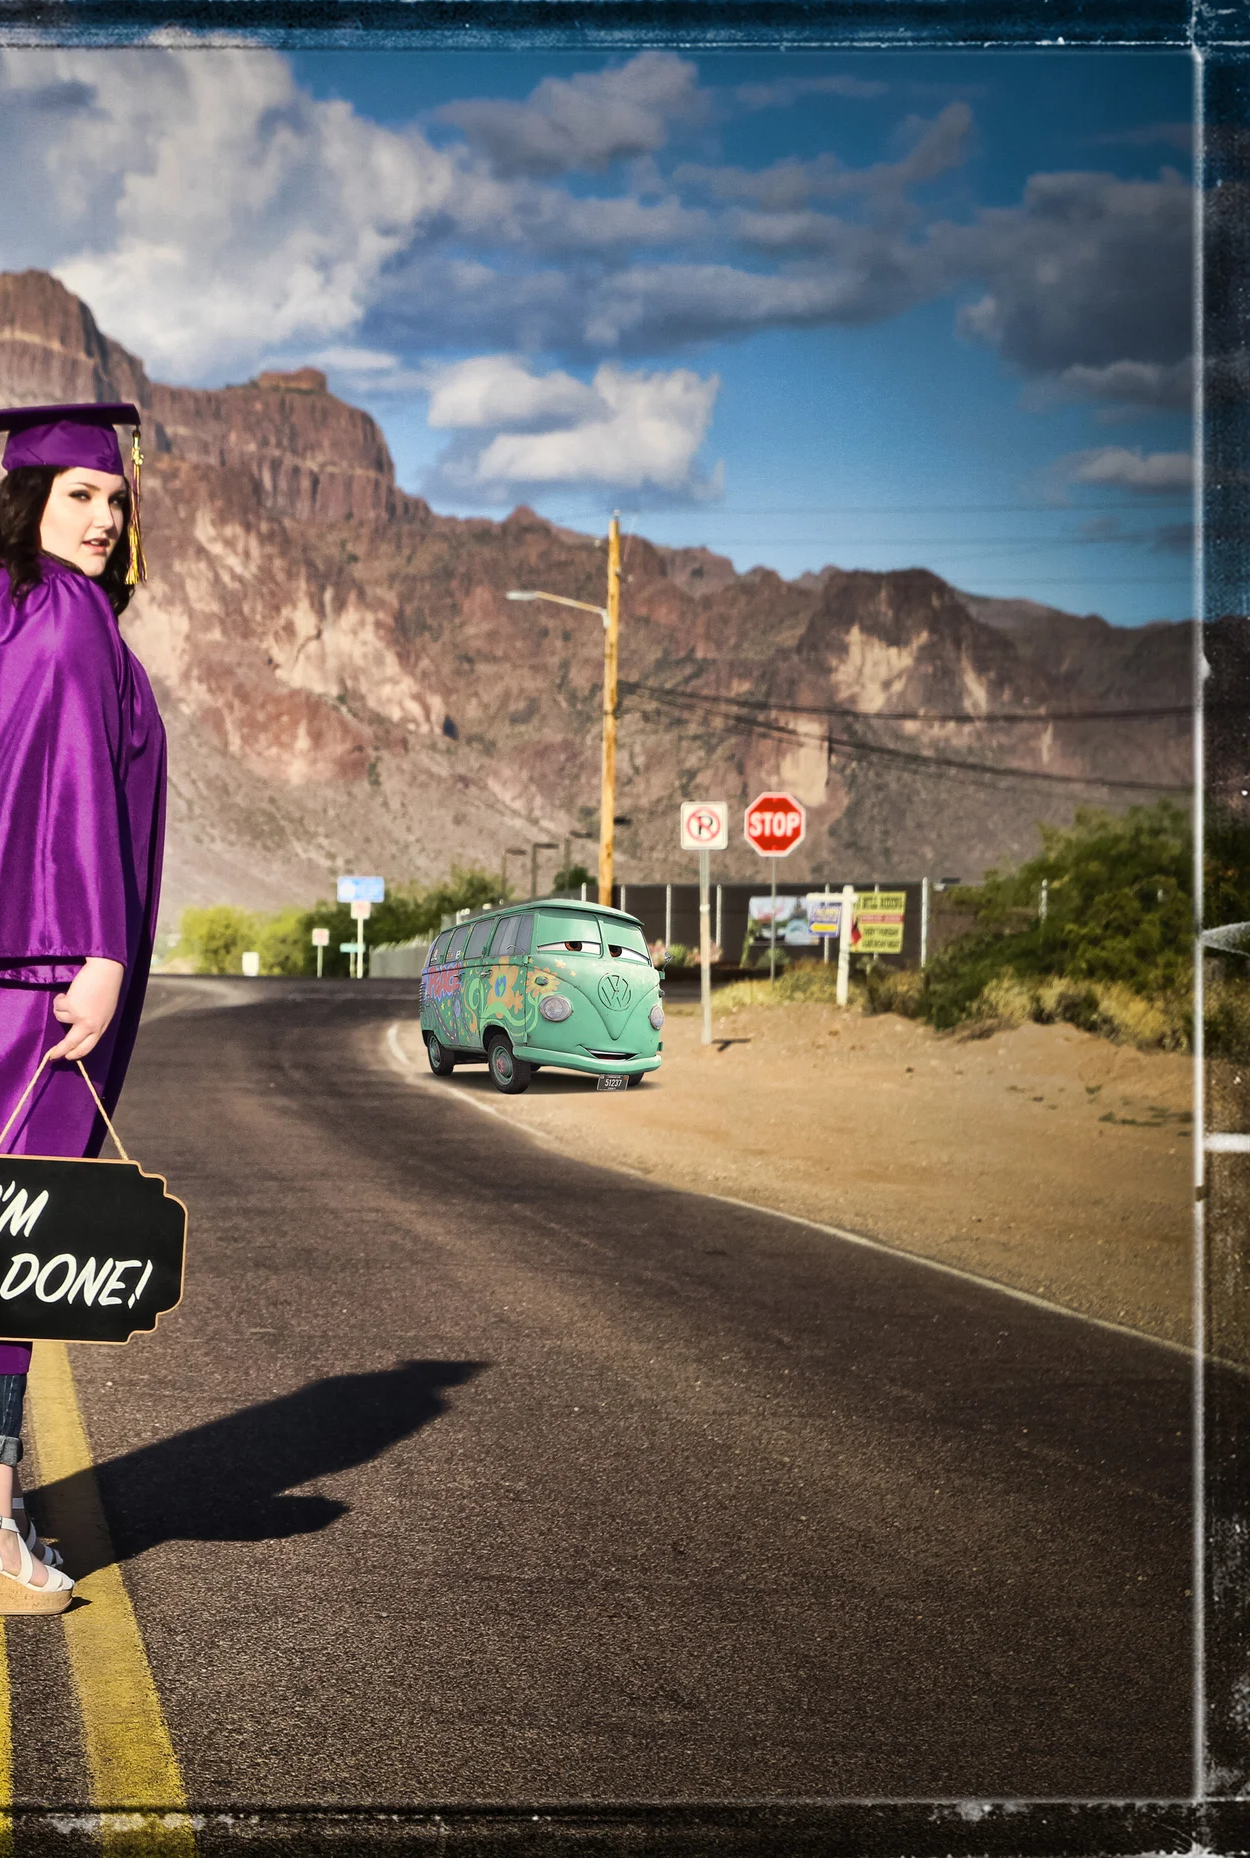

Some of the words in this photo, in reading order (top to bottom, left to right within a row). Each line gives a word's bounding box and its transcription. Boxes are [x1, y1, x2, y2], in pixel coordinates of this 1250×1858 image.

[749, 811, 801, 838] STOP
[604, 1078, 622, 1087] 51237
[0, 1252, 153, 1309] DONE!
